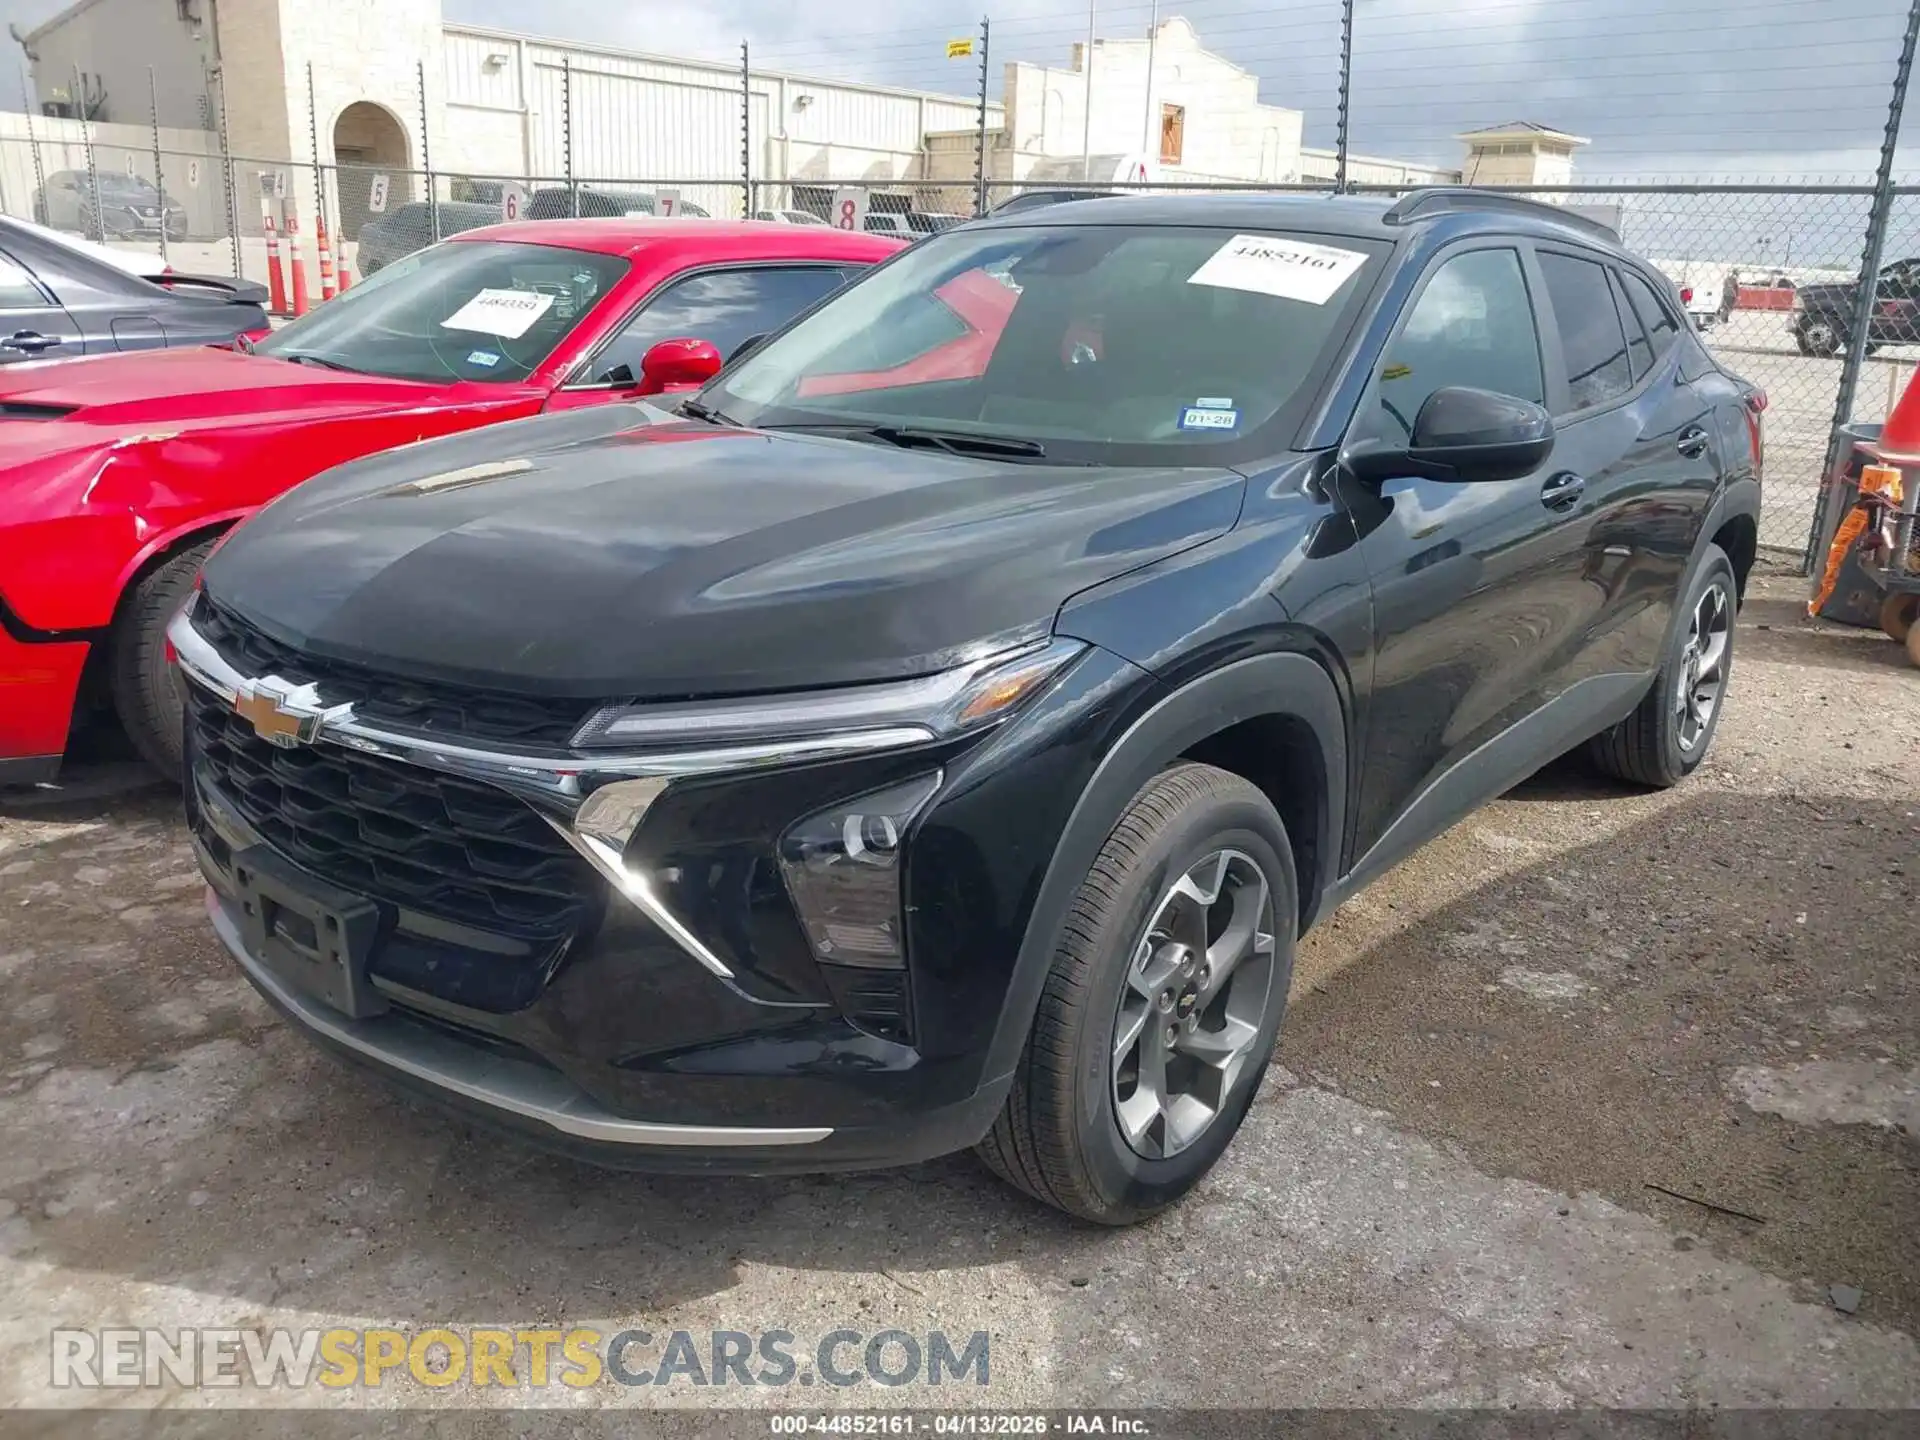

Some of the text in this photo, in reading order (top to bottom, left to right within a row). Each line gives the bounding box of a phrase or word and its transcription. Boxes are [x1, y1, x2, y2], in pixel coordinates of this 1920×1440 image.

[375, 183, 386, 206] 5
[507, 194, 517, 220] 6
[662, 199, 673, 217] 7
[840, 199, 856, 231] 8
[1233, 246, 1338, 271] 44852161
